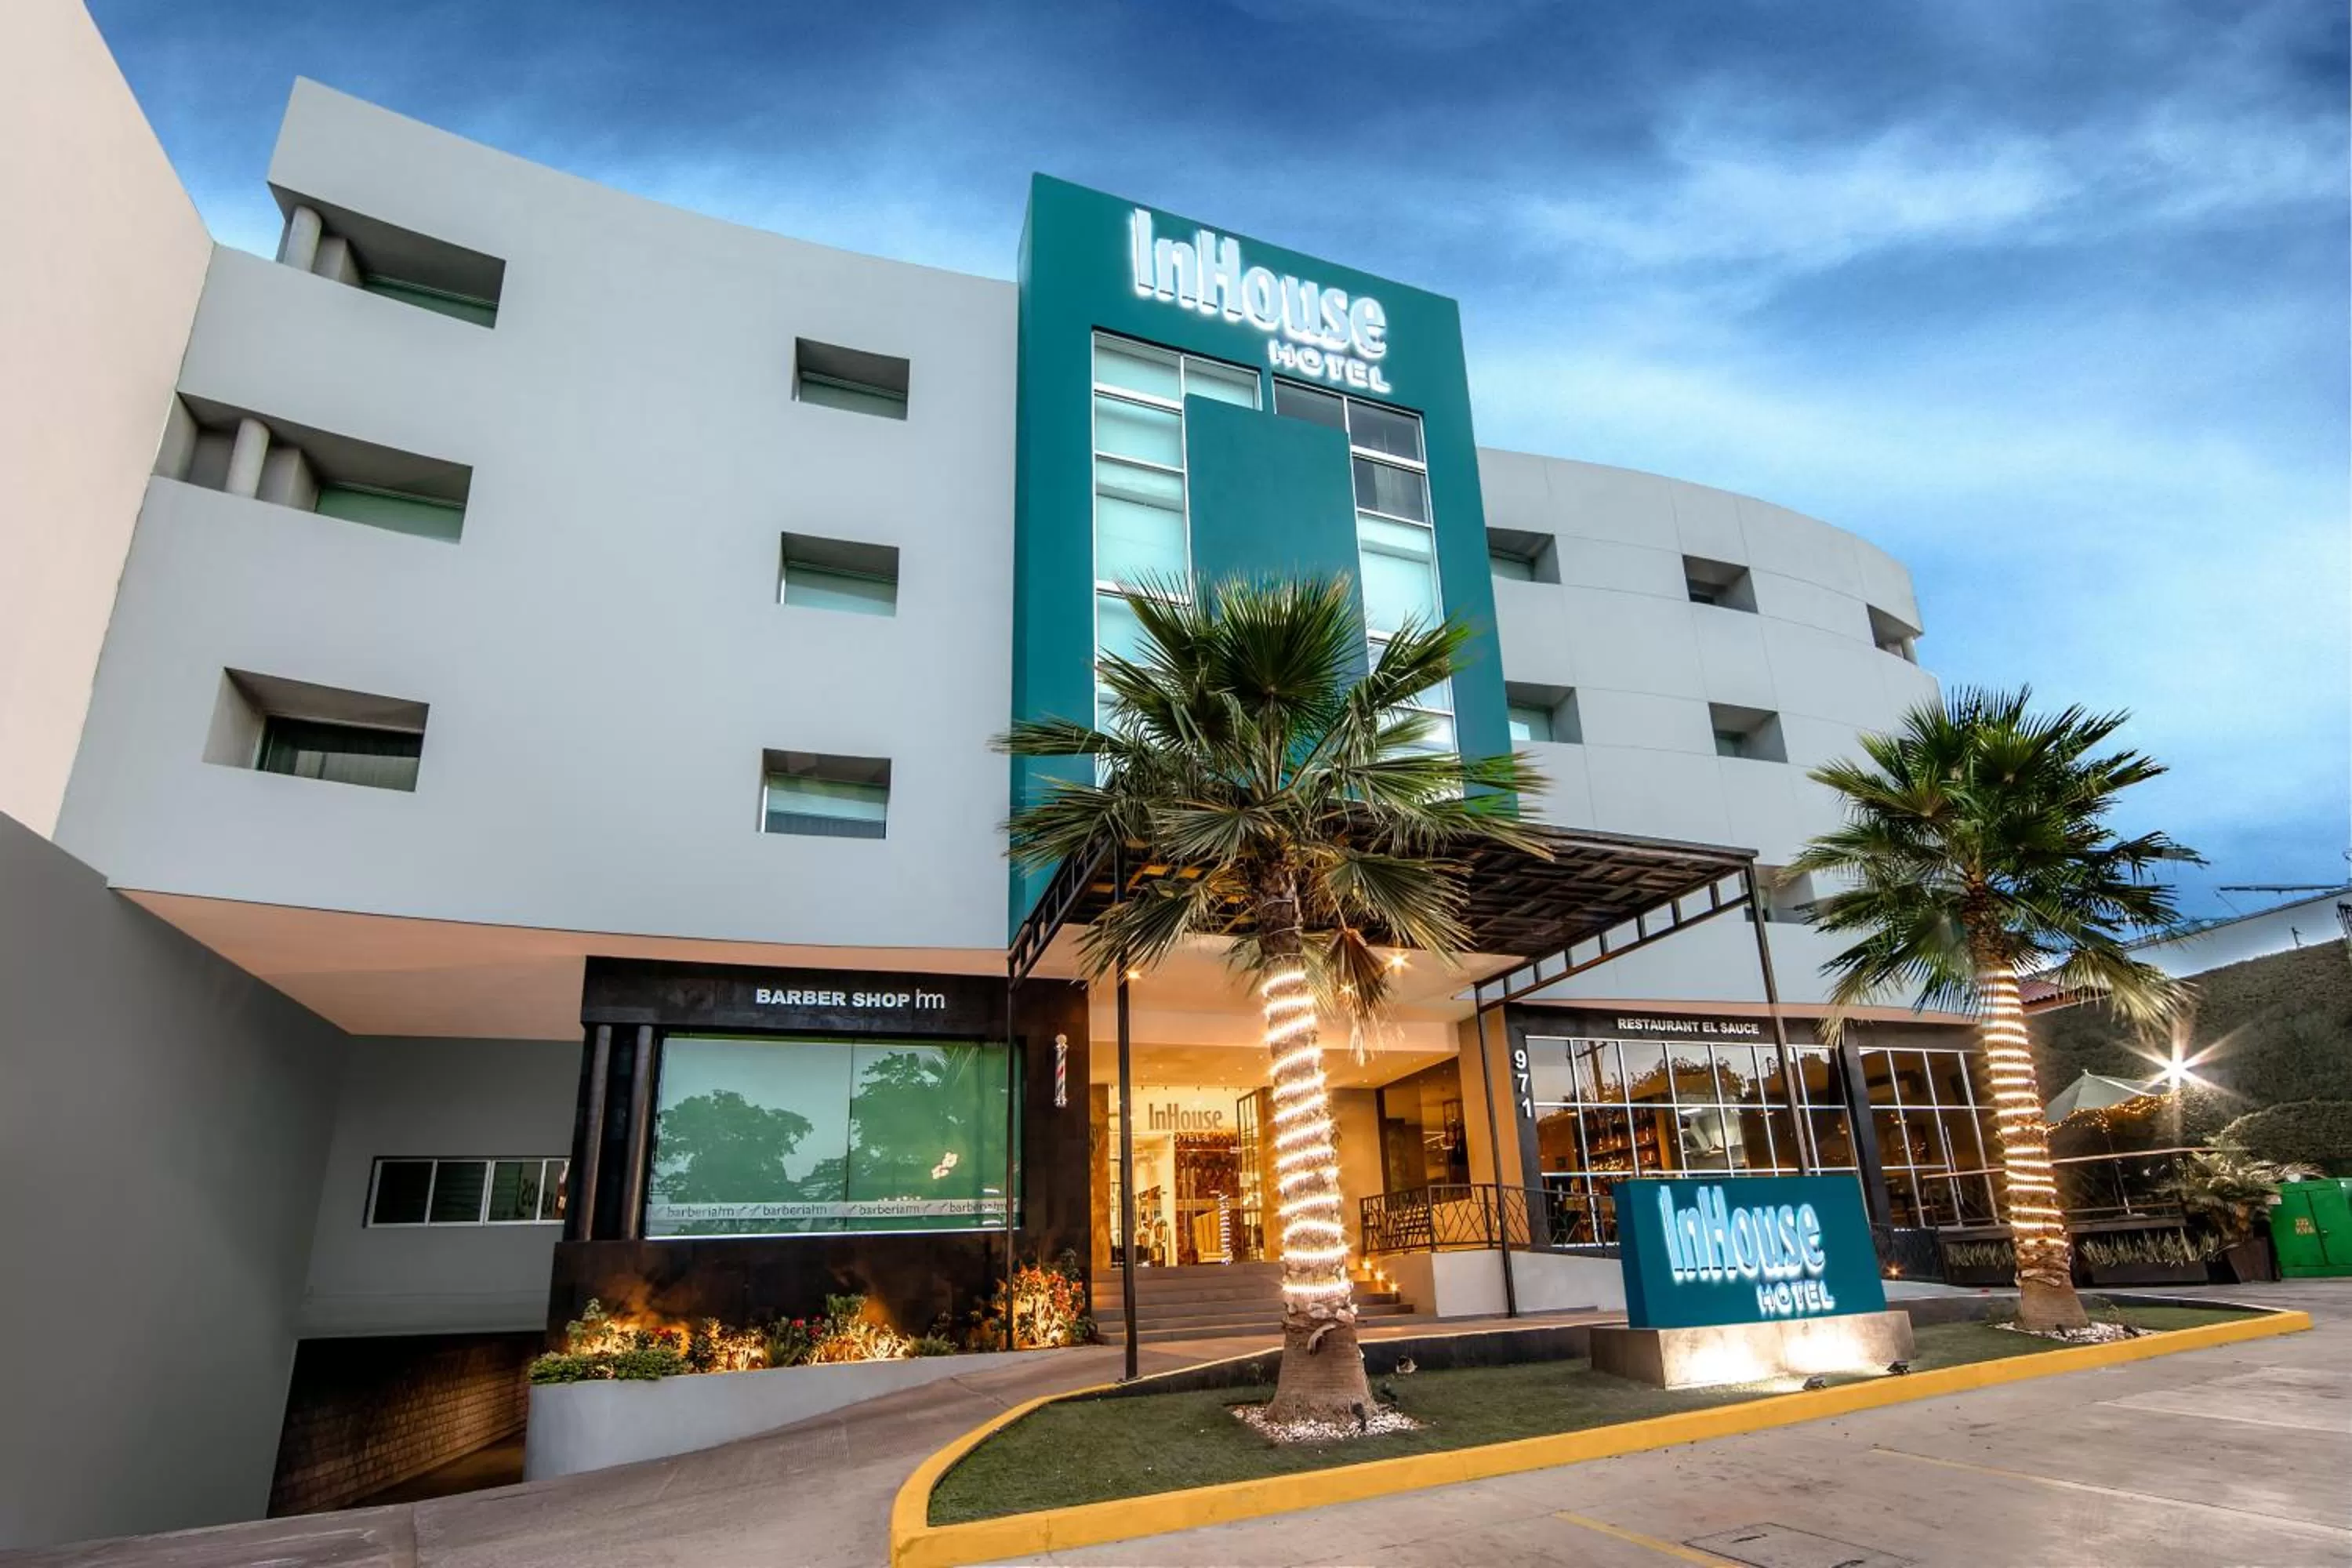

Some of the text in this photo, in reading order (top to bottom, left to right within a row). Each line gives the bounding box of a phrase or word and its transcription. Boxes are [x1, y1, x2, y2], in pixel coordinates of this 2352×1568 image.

[1133, 208, 1387, 358] InHouse
[1269, 339, 1392, 393] HOTEL
[756, 989, 847, 1007] BARBER
[852, 991, 909, 1008] SHOP
[1617, 1018, 1760, 1034] RESTAURANT EL SAUCE
[1149, 1103, 1223, 1130] InHouse
[1659, 1185, 1825, 1279] InHouse
[1757, 1279, 1835, 1315] HOTEL
